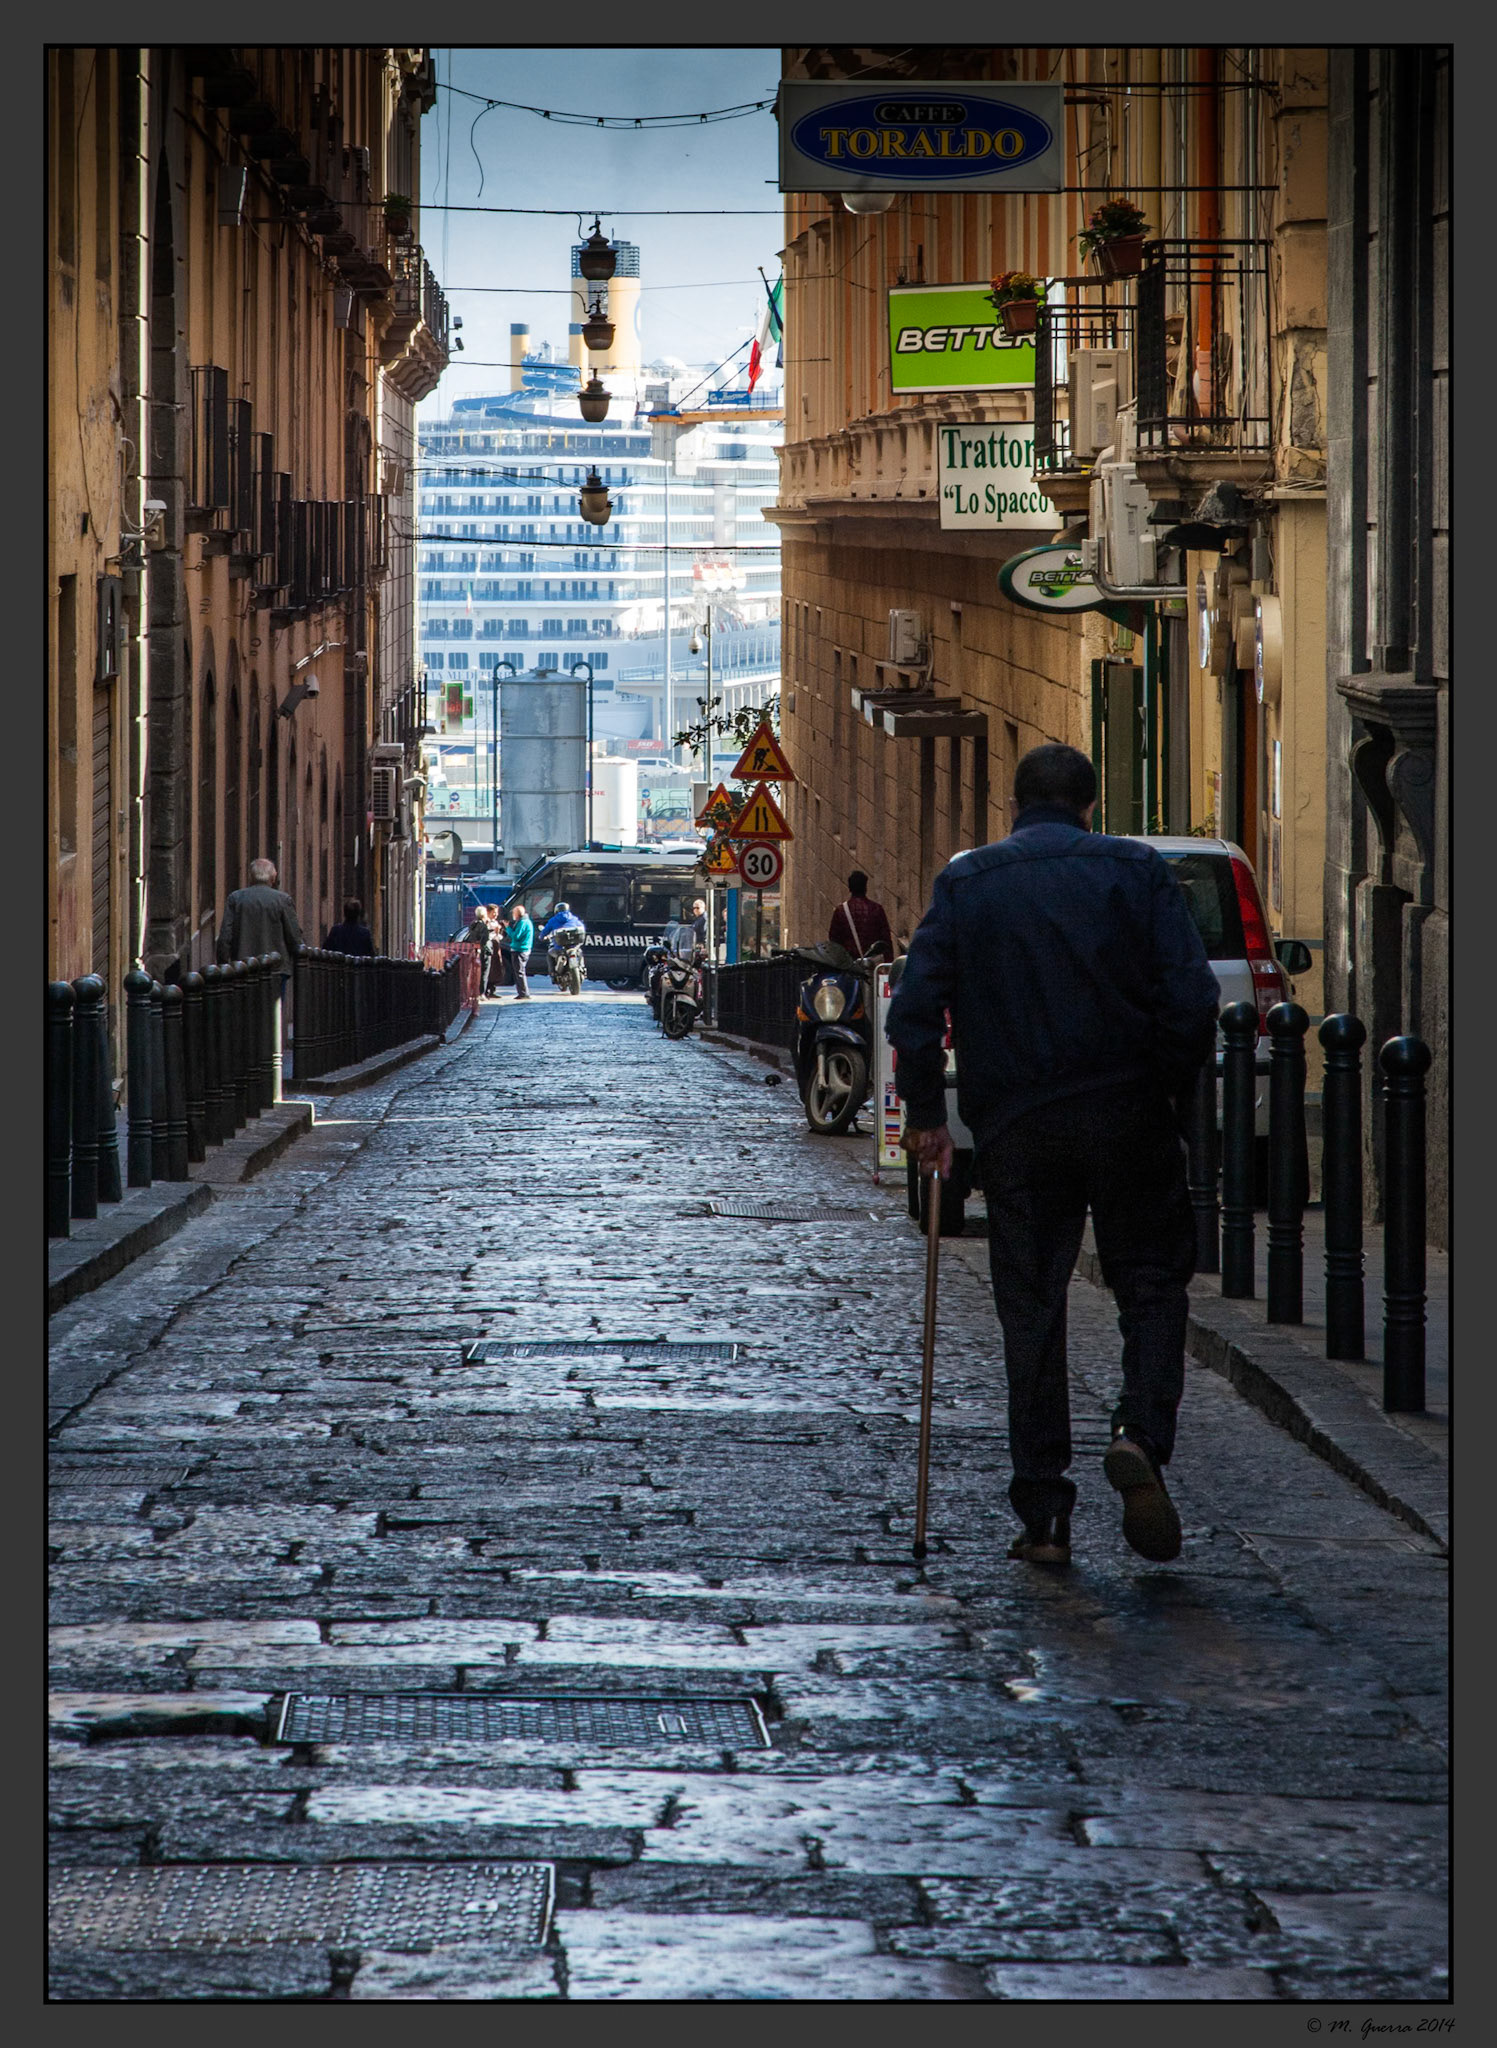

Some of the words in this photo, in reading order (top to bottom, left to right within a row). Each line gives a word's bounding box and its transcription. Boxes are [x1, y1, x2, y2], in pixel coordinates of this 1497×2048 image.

[819, 127, 1025, 160] TORALDO
[984, 483, 1048, 523] Spacco
[747, 853, 773, 876] 30
